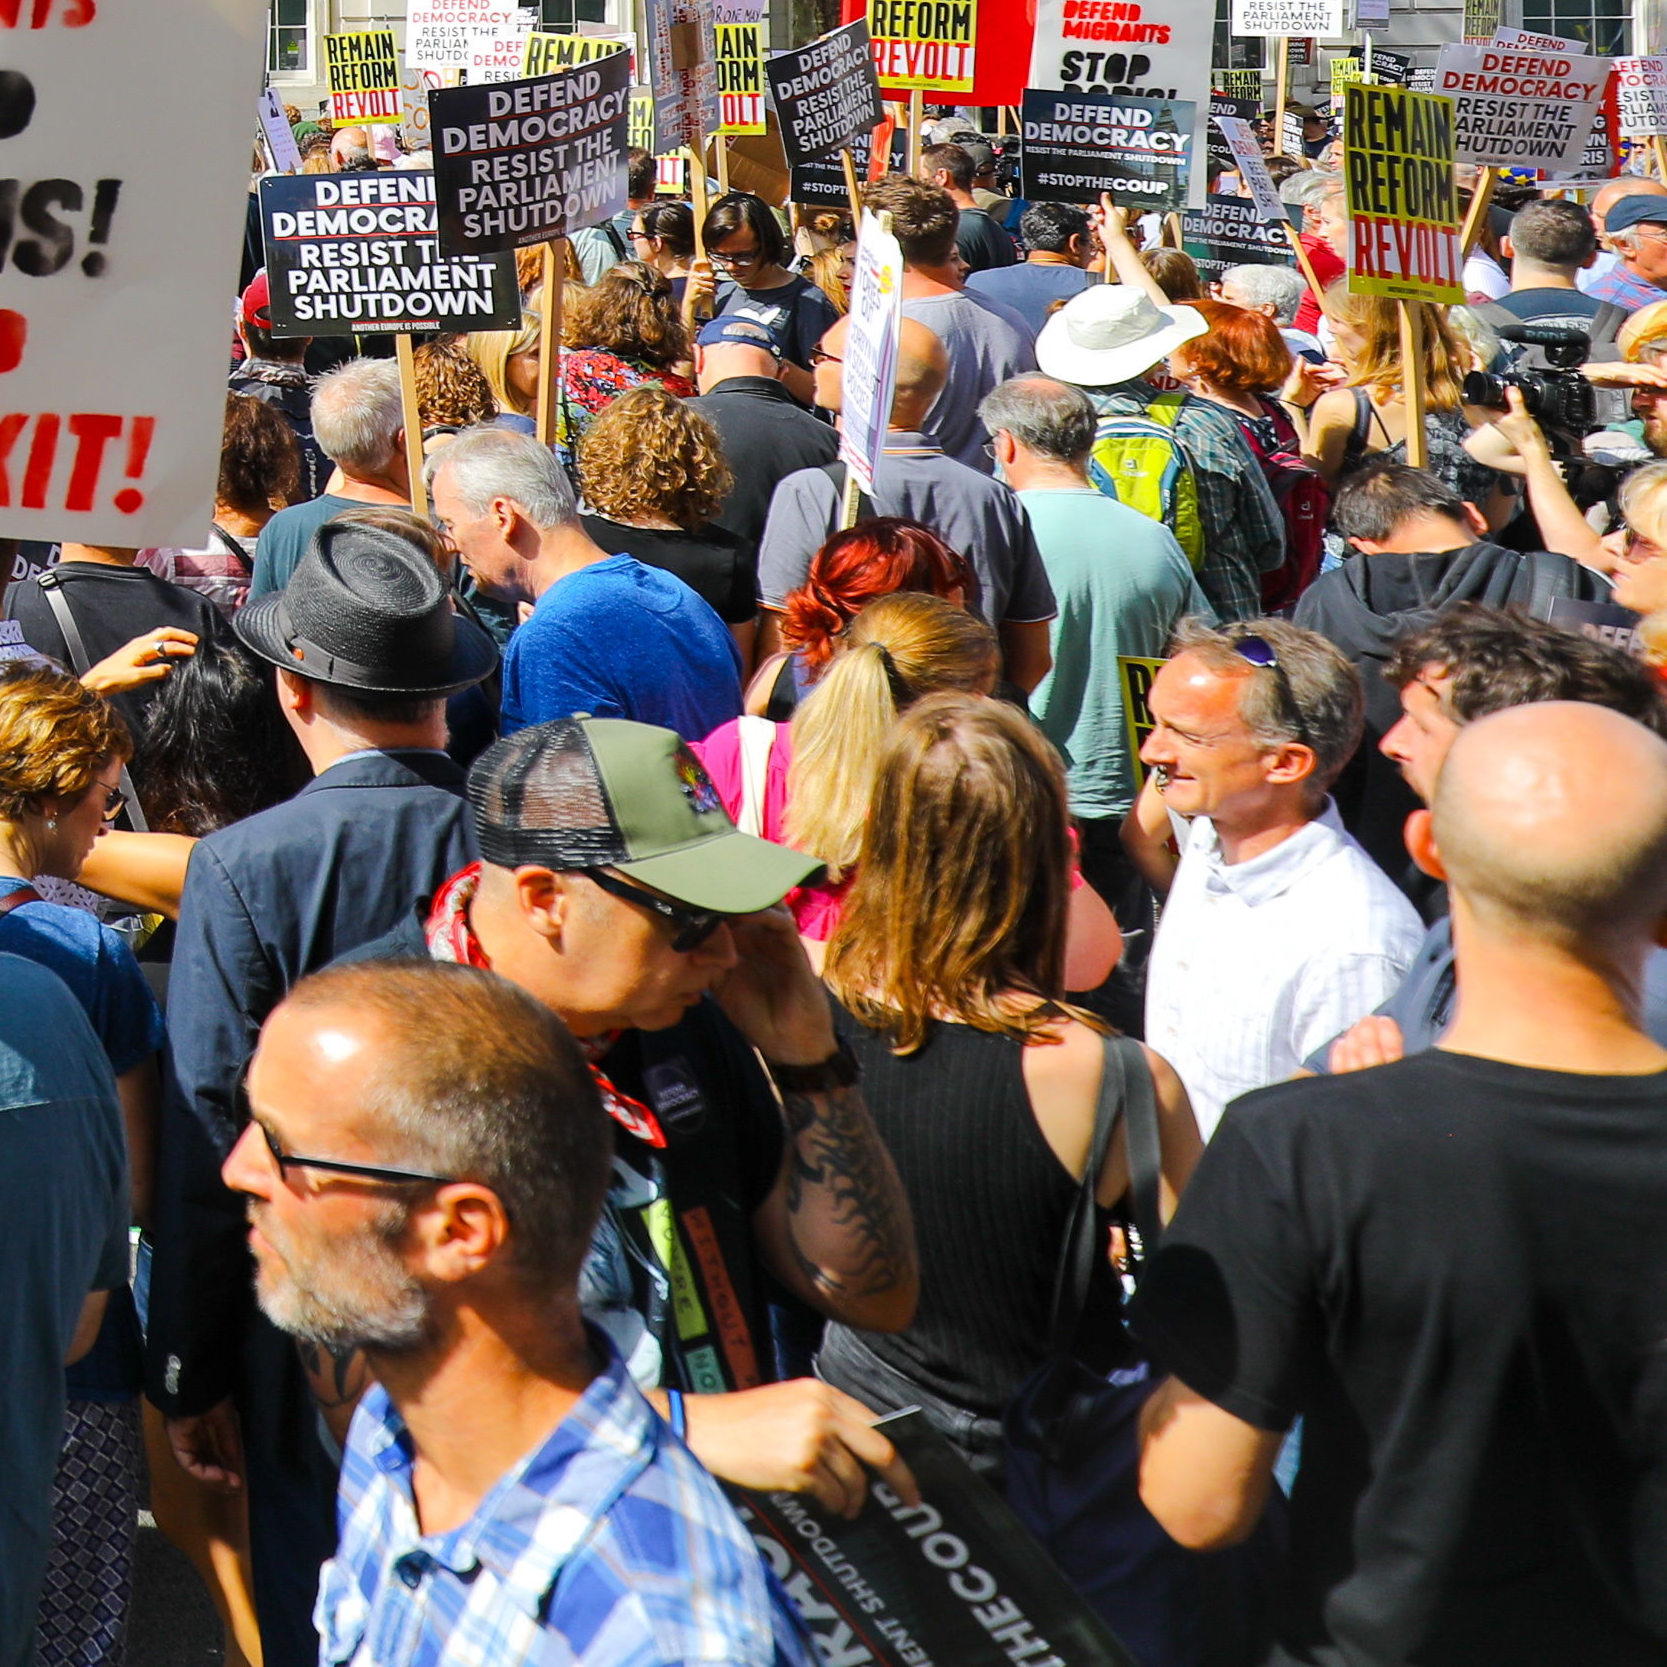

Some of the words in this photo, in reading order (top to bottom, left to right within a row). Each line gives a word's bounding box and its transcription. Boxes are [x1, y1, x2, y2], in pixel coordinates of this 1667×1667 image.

[412, 12, 512, 24] DEMOCRACY
[432, 0, 490, 10] DEFEND
[723, 9, 742, 23] ONE
[744, 9, 762, 22] MAY
[872, 0, 970, 41] REFORM
[1063, 0, 1141, 21] DEFEND
[1243, 11, 1332, 21] PARLIAMENT
[1249, 1, 1292, 11] RESIST
[1299, 1, 1325, 11] THE
[422, 27, 467, 37] RESIST
[471, 27, 499, 38] THE
[1062, 20, 1171, 44] MIGRANTS
[1244, 20, 1329, 30] SHUTDOWN
[327, 33, 394, 64] REMAIN
[798, 33, 852, 72] DEFEND
[870, 38, 970, 81] REVOLT
[330, 60, 397, 92] REFORM
[778, 43, 870, 101] DEMOCRACY
[1061, 50, 1151, 85] STOP
[1223, 72, 1261, 86] REMAIN
[1482, 53, 1572, 77] DEFEND
[489, 70, 602, 118] DEFEND
[1442, 71, 1597, 101] DEMOCRACY
[332, 89, 400, 121] REVOLT
[442, 86, 628, 154] DEMOCRACY
[792, 83, 874, 138] PARLIAMENT
[1055, 103, 1153, 127] DEFEND
[1456, 96, 1528, 120] RESIST
[1533, 101, 1572, 121] THE
[798, 101, 875, 153] SHUTDOWN
[1025, 122, 1192, 152] DEMOCRACY
[1348, 87, 1452, 162] REMAIN
[471, 144, 569, 184] RESIST
[574, 127, 613, 161] THE
[459, 149, 620, 213] PARLIAMENT
[1038, 173, 1169, 195] #STOPTHECOUP
[1350, 150, 1455, 224] REFORM
[464, 177, 617, 238] SHUTDOWN
[300, 240, 408, 269] RESIST
[1354, 213, 1458, 289] REVOLT
[288, 263, 497, 295] PARLIAMENT
[294, 290, 495, 321] SHUTDOWN
